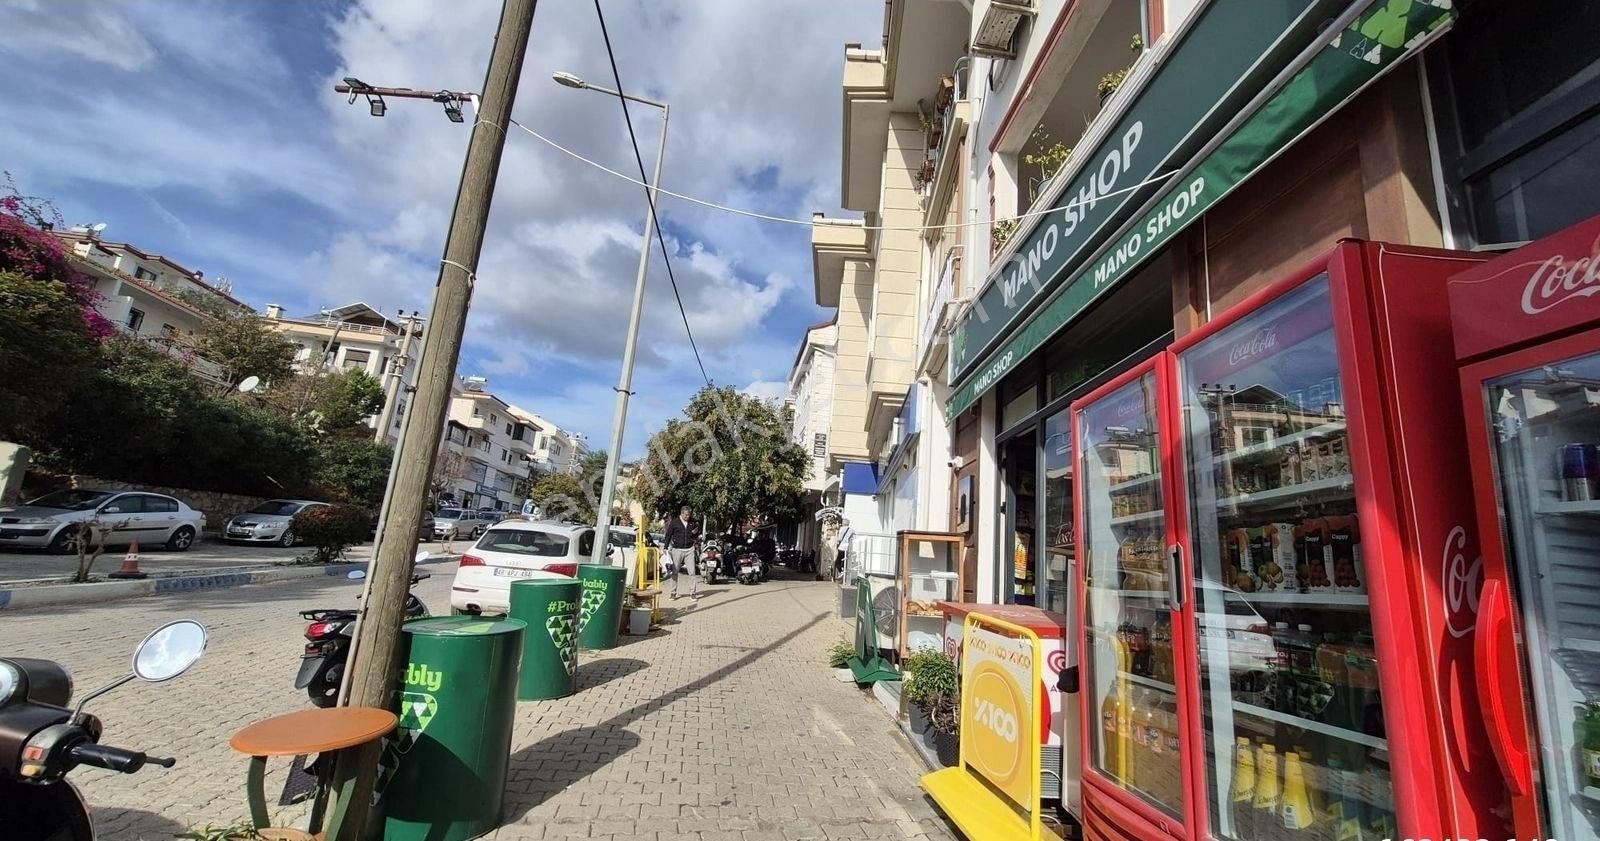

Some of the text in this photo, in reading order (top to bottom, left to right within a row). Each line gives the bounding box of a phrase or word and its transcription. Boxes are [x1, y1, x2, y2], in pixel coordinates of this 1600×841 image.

[1003, 120, 1143, 306] MANO SHOP
[1093, 176, 1205, 290] MANO SHOP
[973, 350, 1013, 395] MANO SHOP
[1331, 533, 1350, 541] Cappy
